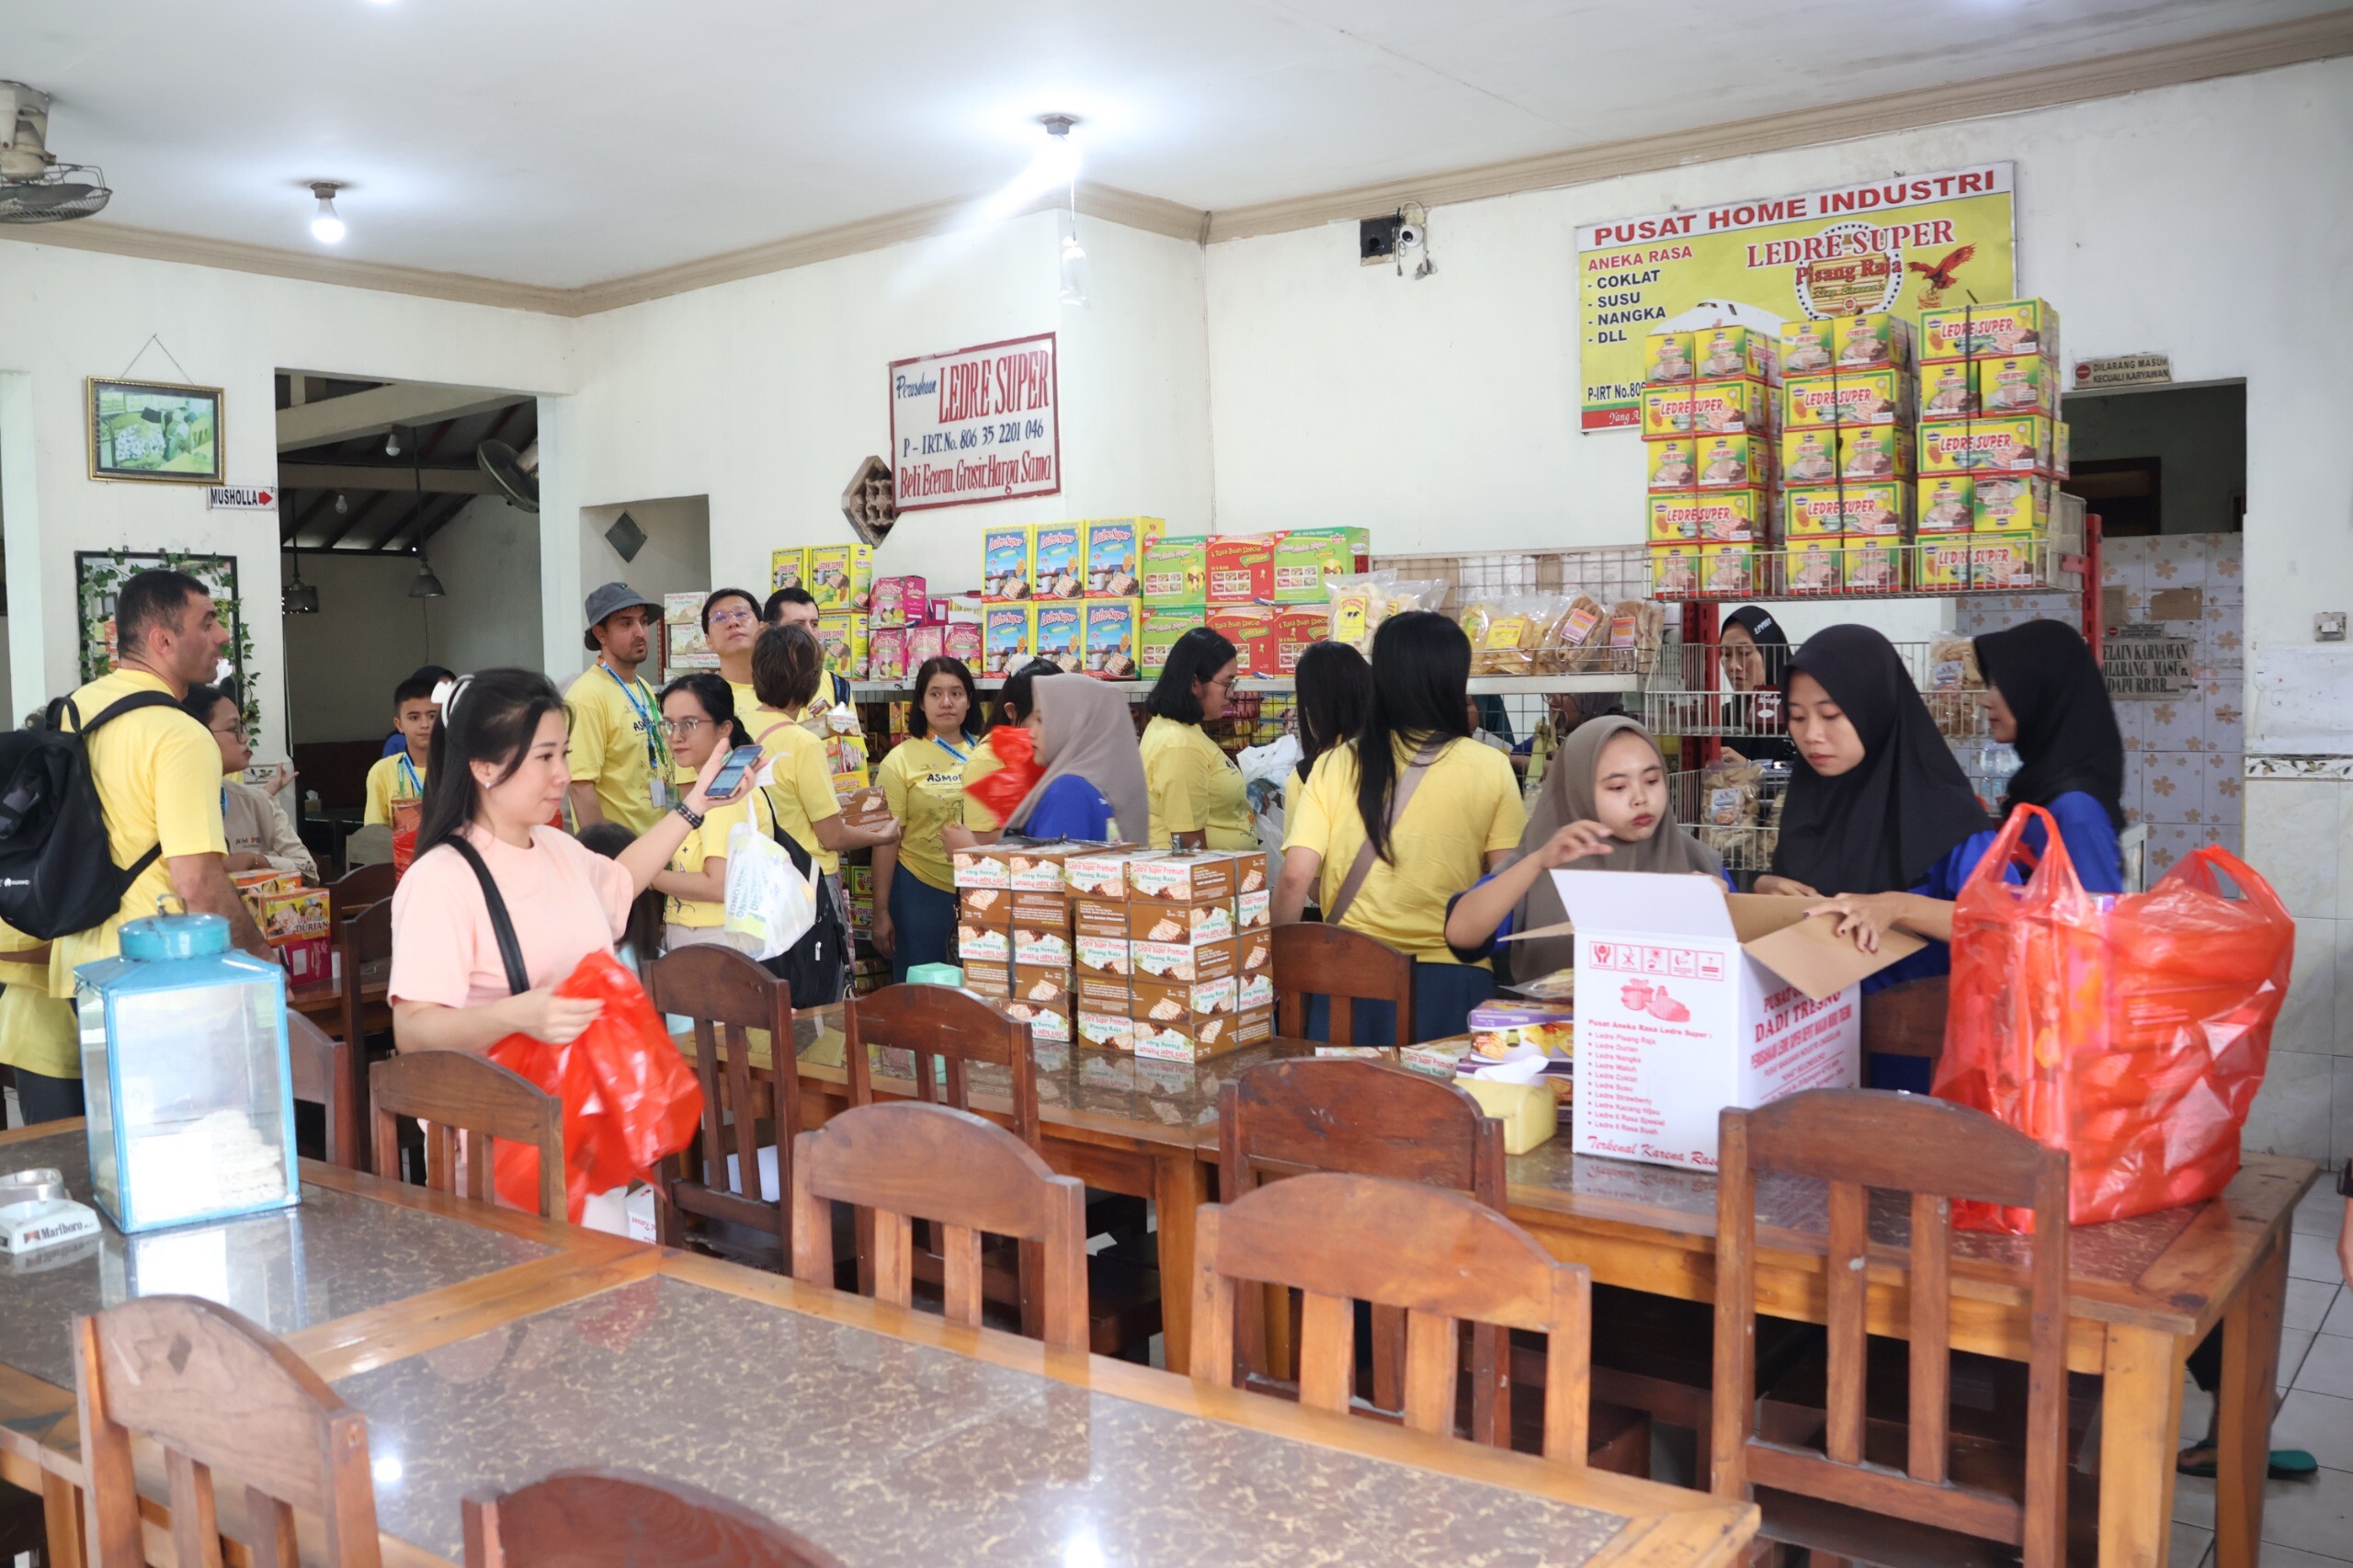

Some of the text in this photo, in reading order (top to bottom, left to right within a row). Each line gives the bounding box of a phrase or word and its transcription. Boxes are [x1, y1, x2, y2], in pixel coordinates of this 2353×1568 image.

[1595, 170, 1994, 245] PUSAT HOME INDUSTRI
[1746, 220, 1955, 267] LEDRE SUPER
[1588, 245, 1692, 271] ANEKA RASA
[1597, 269, 1661, 289] COKLAT
[1796, 256, 1903, 286] Pisang Raja
[1597, 291, 1641, 308] SUSU
[1598, 306, 1666, 325] NANGKA
[1978, 318, 2013, 335] SUPER
[1598, 329, 1628, 344] DLL
[2126, 369, 2169, 381] KARYAWAN
[938, 359, 992, 424] LEDRE
[995, 349, 1050, 415] SUPER
[1587, 385, 1612, 402] P-IRT
[1838, 389, 1872, 403] SUPER
[1661, 398, 1723, 415] LEDRE SUPER
[1608, 412, 1631, 426] Yang
[960, 426, 978, 449] 806
[982, 426, 995, 446] 35
[998, 422, 1021, 444] 2201
[1025, 418, 1044, 440] 046
[1940, 434, 2011, 451] LEDRE SUPER
[900, 464, 921, 499] Beli
[987, 454, 1018, 494] Harga
[1021, 449, 1051, 483] Sama
[210, 488, 258, 506] MUSHOLLA
[1699, 506, 1730, 520] SUPER
[1842, 499, 1876, 514] SUPER
[296, 920, 329, 934] DURIAN
[1756, 1009, 1789, 1043] DADI
[40, 1221, 83, 1240] Marlboro
